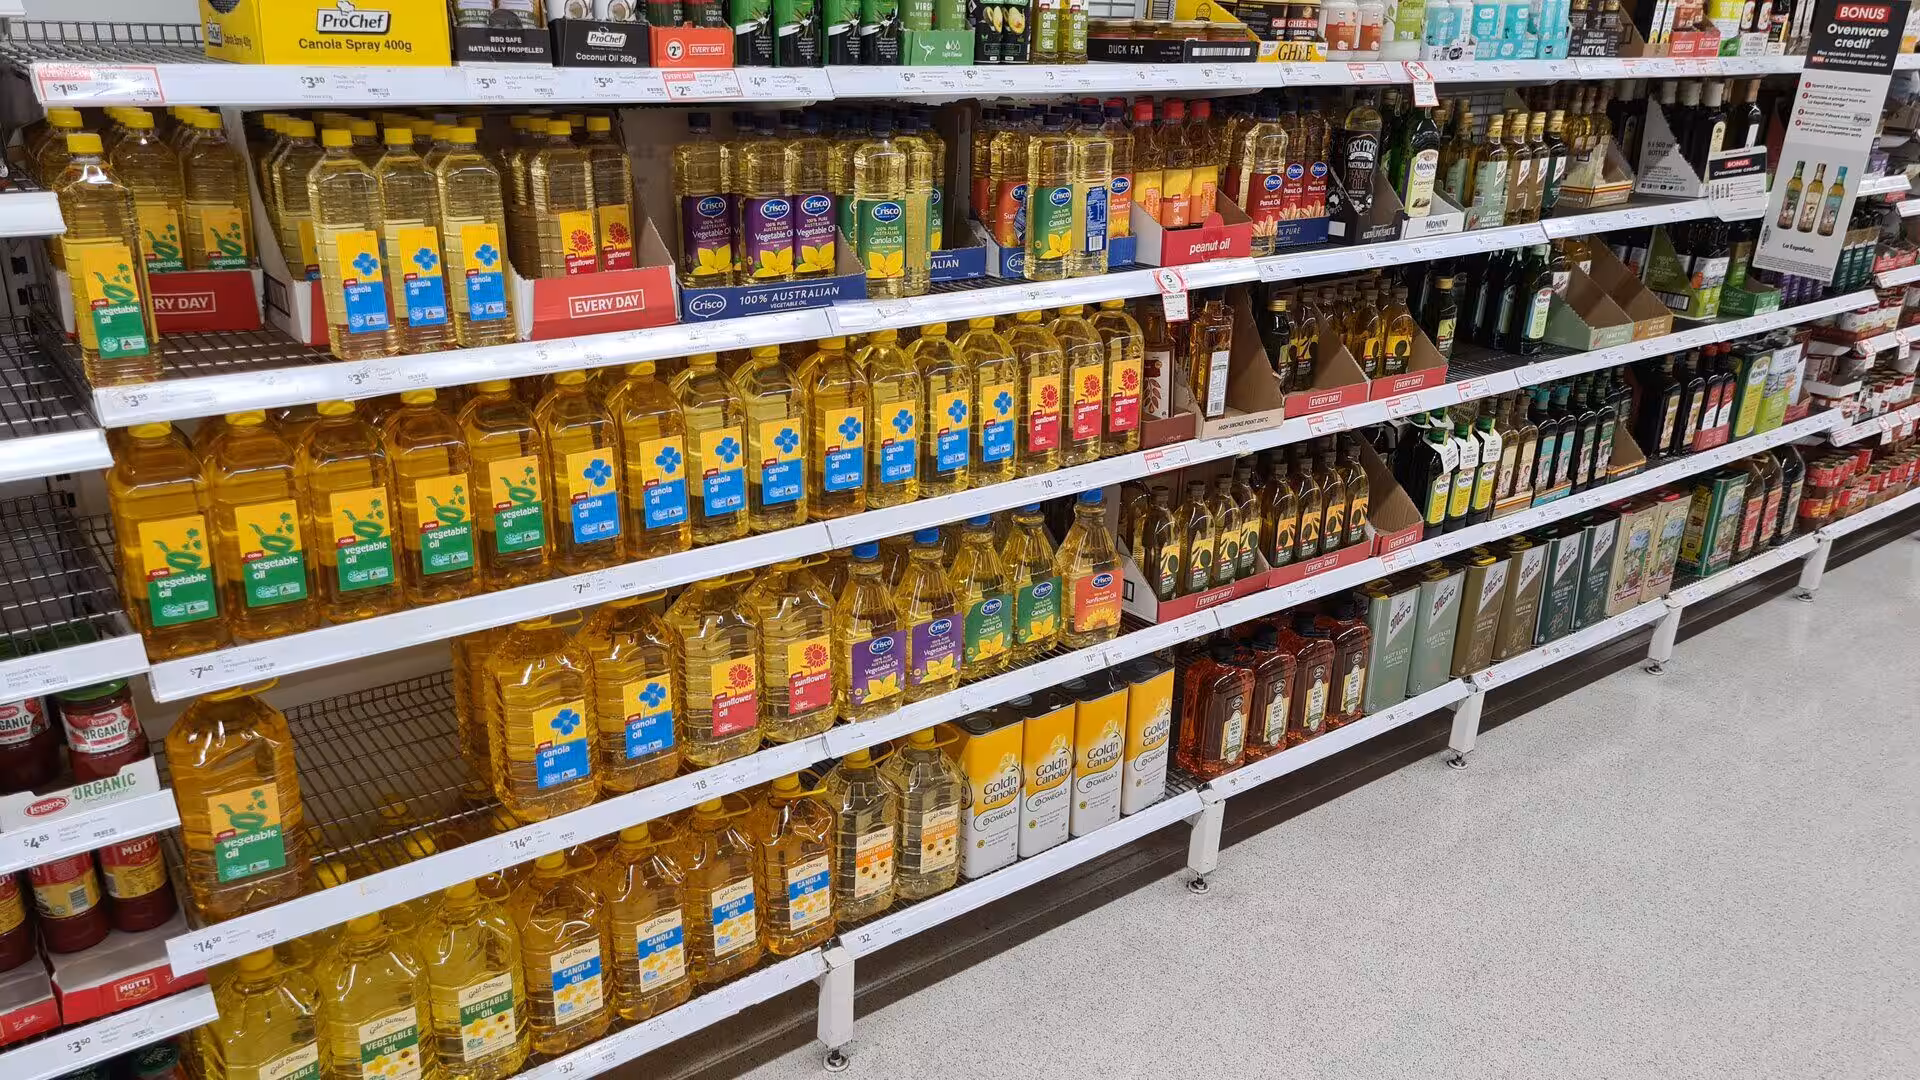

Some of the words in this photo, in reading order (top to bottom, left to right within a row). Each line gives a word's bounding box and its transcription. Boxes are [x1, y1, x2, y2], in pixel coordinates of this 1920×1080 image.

[1840, 7, 1885, 20] BONUS
[322, 15, 386, 30] ProChef
[1827, 23, 1889, 37] Ovenware
[504, 36, 521, 44] SAFE
[590, 34, 623, 44] ProChef
[298, 38, 342, 51] Canola
[345, 39, 381, 52] Spray
[384, 39, 412, 53] 400g
[507, 46, 544, 54] PROPELLED
[692, 46, 707, 54] EVERY
[1109, 45, 1126, 54] DUCK
[1131, 46, 1145, 55] FAT
[1581, 46, 1595, 56] MCT
[1595, 46, 1607, 55] OIL
[576, 53, 606, 62] Coconut
[608, 54, 618, 62] Oil
[620, 56, 637, 64] 260g
[1727, 159, 1749, 168] BONUS
[1287, 167, 1303, 177] Crisco
[1311, 165, 1327, 174] Crisco
[1111, 181, 1129, 190] Crisco
[1265, 177, 1281, 188] Crisco
[1051, 190, 1070, 201] Crisco
[700, 202, 724, 210] Crisco
[763, 203, 788, 213] Crisco
[803, 199, 829, 209] Crisco
[874, 208, 900, 218] Crisco
[796, 227, 825, 237] Vegetable
[826, 224, 835, 232] Oil
[1286, 227, 1301, 235] PURE
[754, 231, 784, 241] Vegetable
[869, 236, 889, 244] Canola
[890, 235, 902, 243] Oil
[1189, 240, 1218, 255] peanut
[1220, 238, 1230, 250] oil
[607, 250, 630, 258] sunflower
[148, 261, 182, 269] vegetable
[213, 258, 246, 266] vegetable
[569, 258, 595, 267] sunflower
[410, 279, 431, 288] canola
[471, 275, 491, 283] canola
[350, 285, 372, 294] canola
[739, 294, 768, 305] 100%
[772, 287, 840, 302] AUSTRALIAN
[178, 297, 209, 310] DAY
[575, 297, 613, 313] EVERY
[616, 295, 639, 308] DAY
[691, 299, 724, 311] Crisco
[770, 301, 798, 309] VEGETABLE
[99, 305, 138, 316] vegetable
[101, 316, 112, 324] oil
[1396, 380, 1411, 390] EVERY
[1412, 378, 1423, 386] DAY
[1115, 397, 1137, 407] sunflower
[1310, 396, 1328, 407] EVERY
[1328, 394, 1340, 403] DAY
[1078, 403, 1099, 413] sunflower
[1034, 415, 1057, 425] sunflower
[988, 425, 1004, 434] canola
[942, 434, 959, 443] canola
[886, 445, 904, 454] canola
[831, 452, 851, 462] canola
[768, 465, 789, 474] canola
[709, 475, 731, 485] canola
[650, 487, 672, 496] canola
[578, 499, 602, 510] canola
[501, 506, 539, 519] vegetable
[503, 520, 513, 528] oil
[428, 526, 468, 540] vegetable
[429, 540, 440, 548] oil
[1390, 538, 1404, 549] EVERY
[1404, 534, 1415, 544] DAY
[343, 541, 387, 555] vegetable
[252, 555, 298, 570] vegetable
[346, 556, 357, 564] oil
[157, 573, 207, 588] vegetable
[253, 571, 265, 580] oil
[1094, 575, 1112, 586] Crisco
[159, 588, 172, 598] oil
[1199, 593, 1218, 606] EVERY
[1219, 589, 1232, 600] DAY
[794, 672, 827, 687] sunflower
[795, 687, 804, 696] oil
[718, 694, 753, 709] sunflower
[719, 709, 728, 718] oil
[631, 717, 657, 730] canola
[83, 720, 128, 741] ORGANIC
[632, 730, 642, 739] oil
[1143, 728, 1168, 747] Canola
[542, 744, 570, 759] canola
[544, 759, 554, 768] oil
[1086, 752, 1118, 769] Canola
[1035, 767, 1069, 787] Canola
[72, 773, 137, 800] ORGANIC
[692, 780, 707, 791] $18
[983, 786, 1018, 806] Canola
[223, 829, 278, 848] vegetable
[225, 849, 239, 860] oil
[796, 875, 822, 889] CANOLA
[805, 885, 815, 893] OIL
[721, 898, 747, 914] CANOLA
[729, 909, 740, 918] OIL
[647, 931, 674, 947] CANOLA
[655, 942, 667, 951] OIL
[562, 962, 592, 978] CANOLA
[571, 974, 584, 984] OIL
[119, 977, 151, 993] MUTTI
[465, 993, 509, 1015] VEGETABLE
[481, 1008, 495, 1018] OIL
[365, 1028, 413, 1051] VEGETABLE
[383, 1045, 398, 1055] OIL
